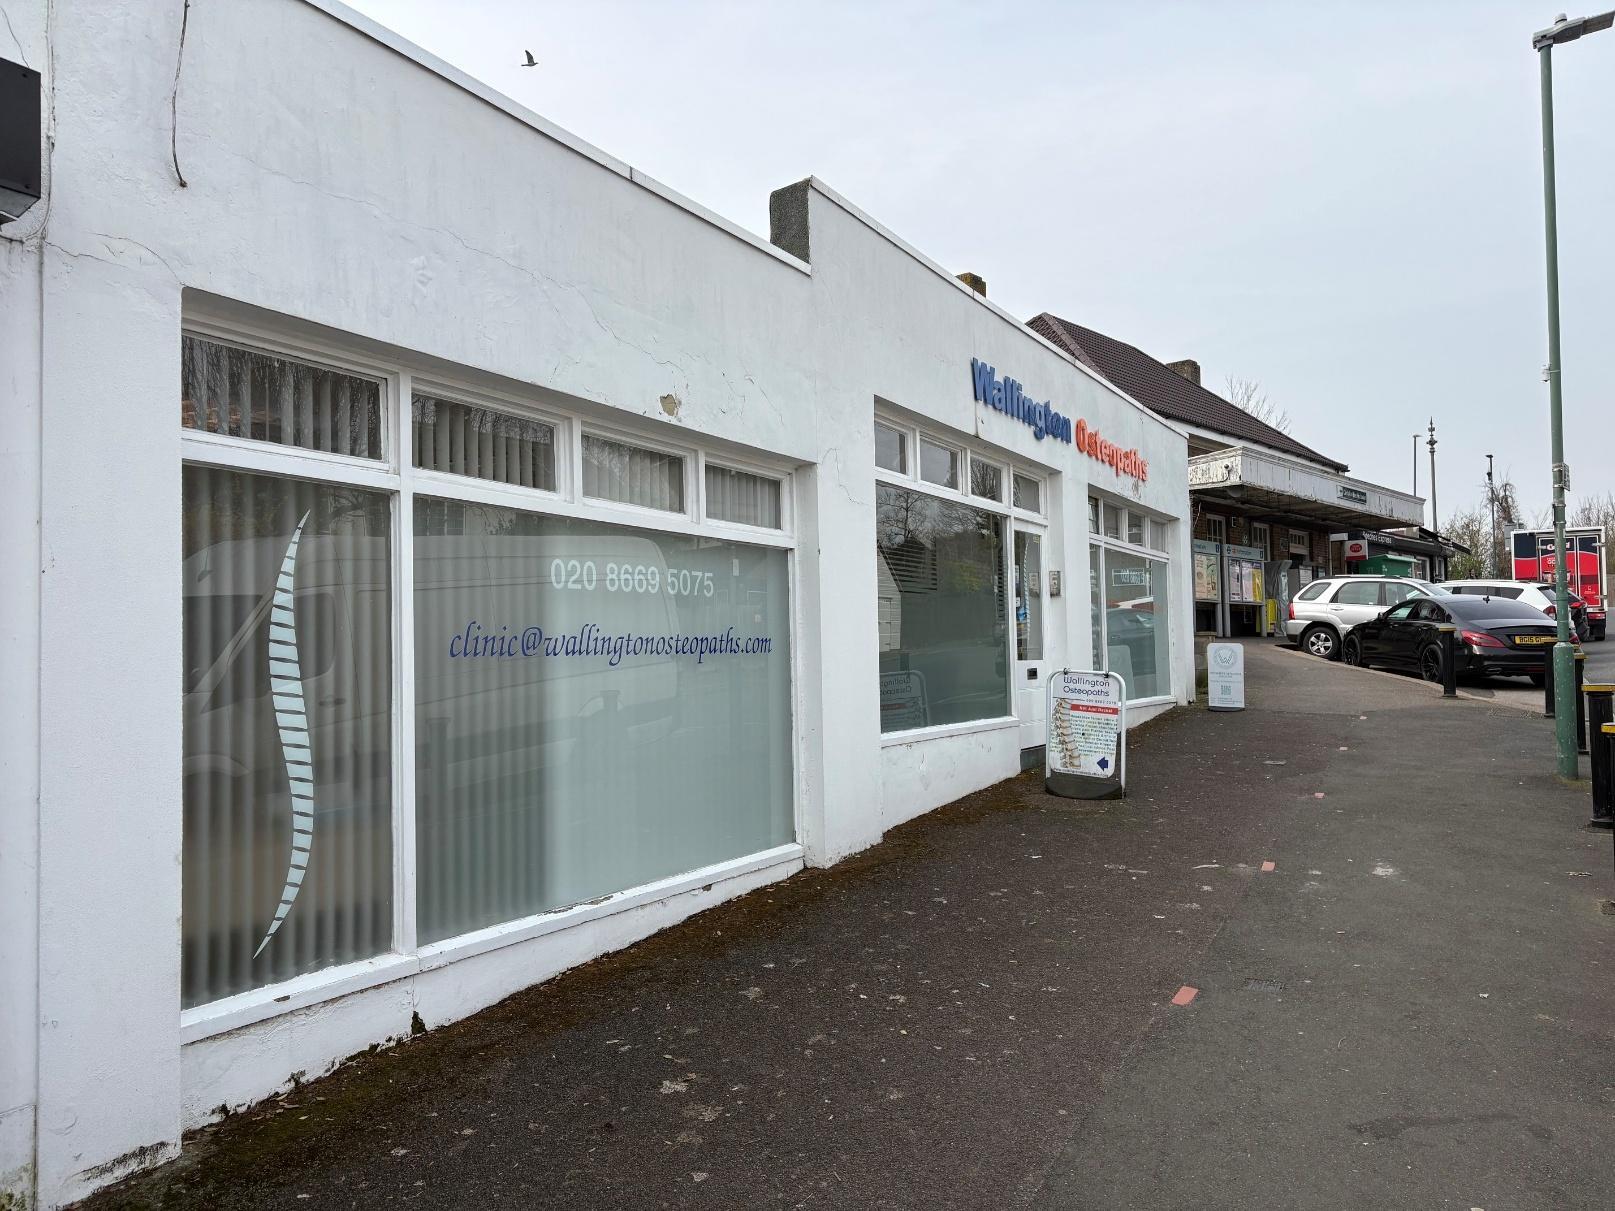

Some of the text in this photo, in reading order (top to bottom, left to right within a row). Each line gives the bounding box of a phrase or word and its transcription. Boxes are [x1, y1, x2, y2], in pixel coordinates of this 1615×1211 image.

[971, 357, 1149, 481] Wallington Osteopaths
[550, 558, 714, 597] 020 8669 5075
[449, 620, 773, 667] clinic@wallingtonosteopaths.com
[1063, 675, 1110, 688] Wallington
[1063, 685, 1110, 697] Osteopaths
